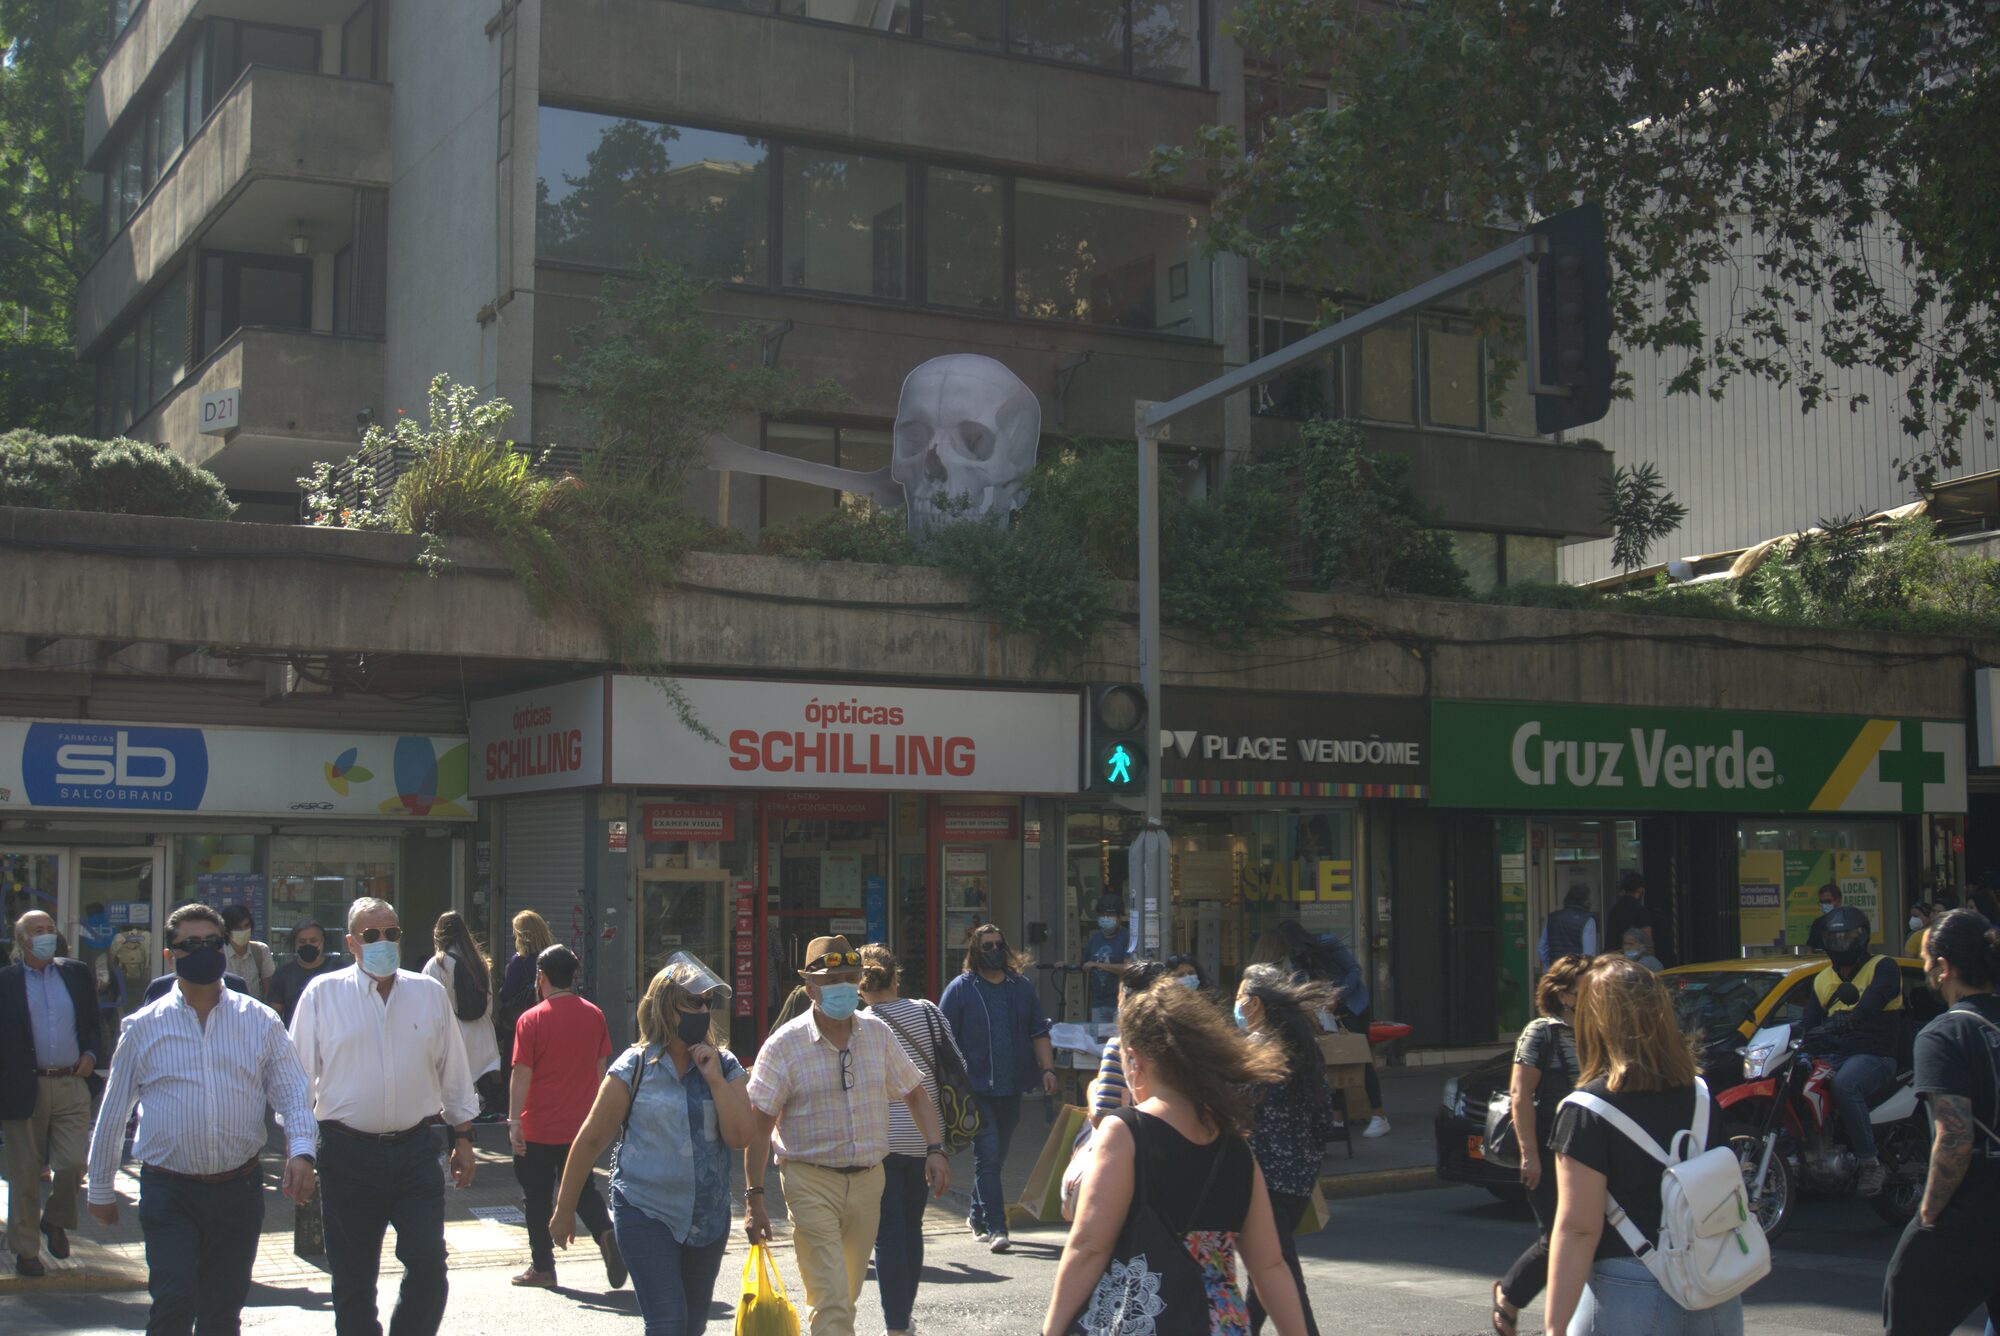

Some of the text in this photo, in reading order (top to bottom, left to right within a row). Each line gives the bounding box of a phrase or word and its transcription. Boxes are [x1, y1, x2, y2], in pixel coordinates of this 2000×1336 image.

[204, 397, 233, 422] D21
[512, 702, 552, 733] ópticas
[805, 697, 904, 728] ópticas
[58, 735, 115, 743] FARMACIAS
[1203, 735, 1287, 761] PLACE
[56, 731, 176, 787] sb
[485, 730, 582, 781] SCHILLING
[728, 729, 976, 777] SCHILLING
[1512, 721, 1776, 790] Cruz Verde
[60, 788, 174, 802] SALCOBRAND
[654, 819, 721, 828] EXAMEN VISUAL
[1244, 860, 1352, 902] SALE
[1842, 882, 1868, 894] LOCAL
[1740, 894, 1779, 906] COLMENA
[1843, 895, 1876, 906] ABIERTO
